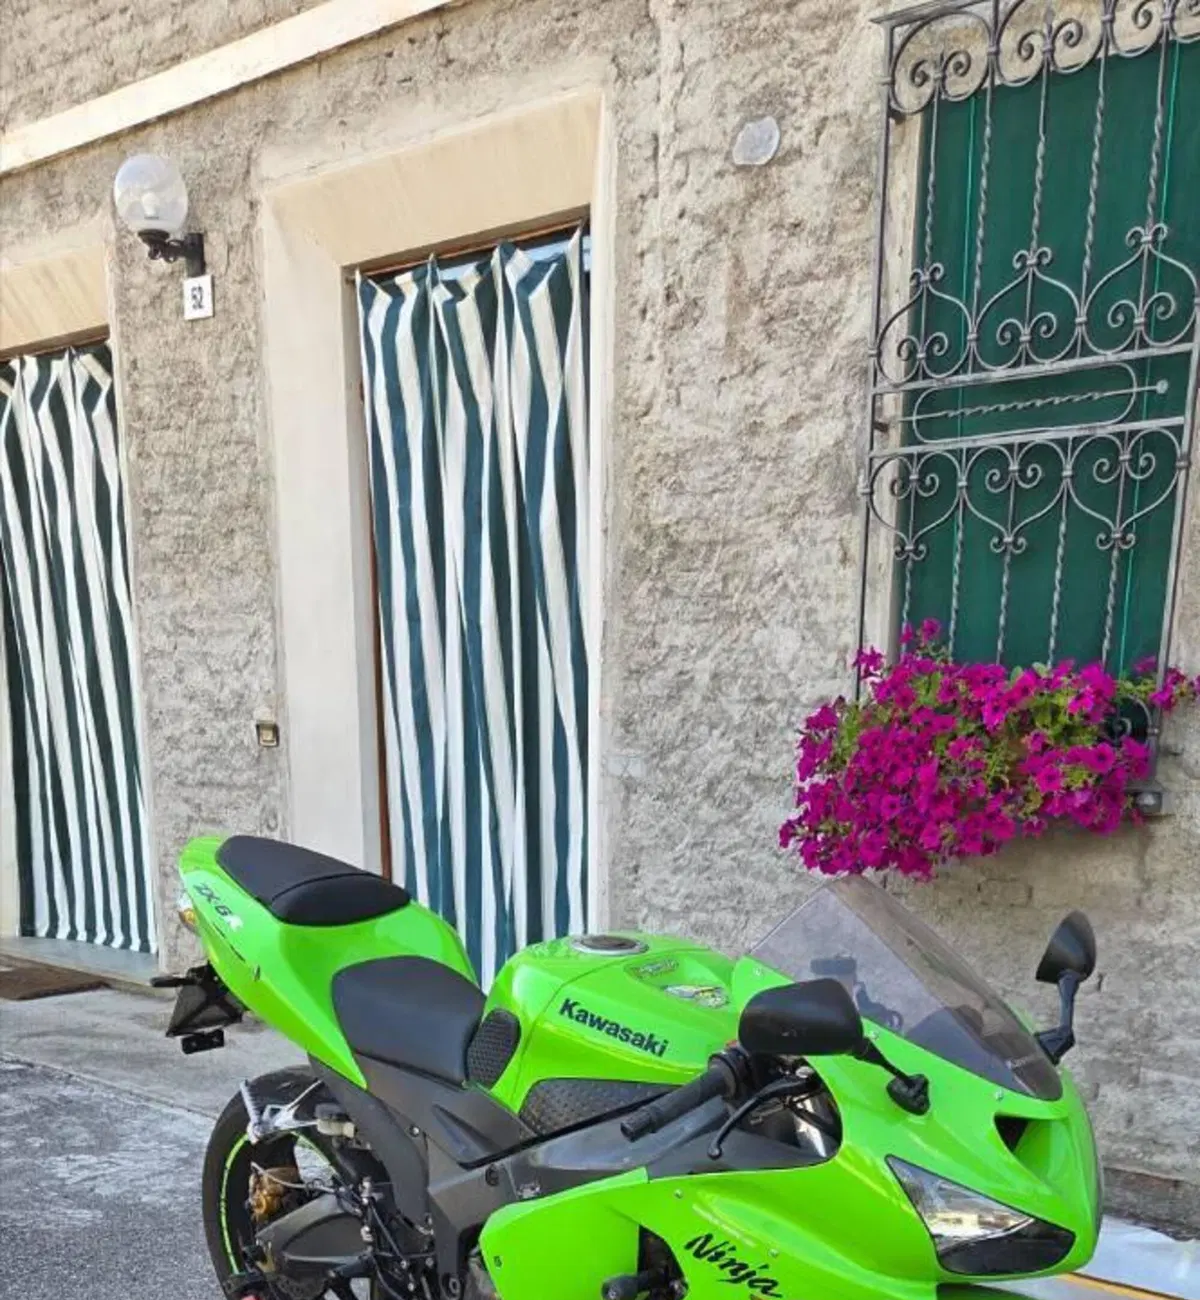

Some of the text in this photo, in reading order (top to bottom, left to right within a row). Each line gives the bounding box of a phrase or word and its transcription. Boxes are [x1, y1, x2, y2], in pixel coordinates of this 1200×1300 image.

[191, 285, 204, 310] 52
[559, 998, 670, 1058] Kawasaki
[683, 1233, 783, 1298] Ninja
